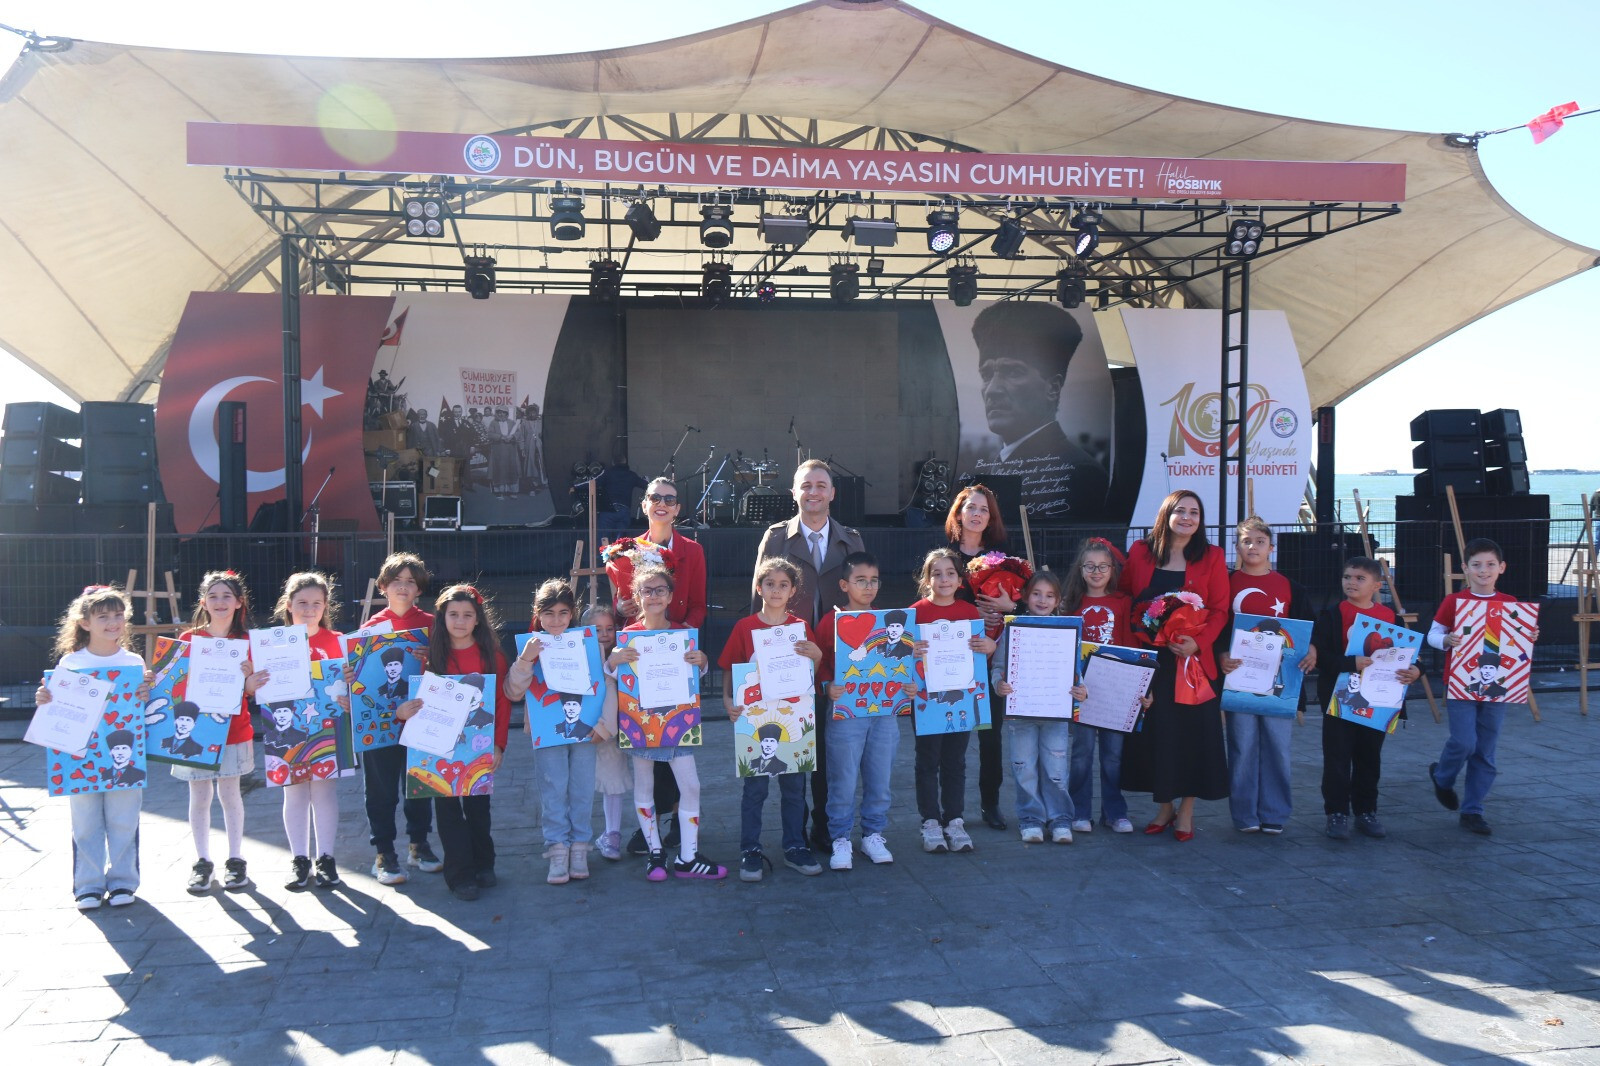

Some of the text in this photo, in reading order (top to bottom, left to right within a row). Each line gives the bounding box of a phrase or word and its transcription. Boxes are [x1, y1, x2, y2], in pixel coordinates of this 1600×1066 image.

[514, 143, 584, 174] DÜN,
[595, 148, 696, 174] BUGÜN
[706, 155, 742, 176] VE
[752, 153, 843, 181] DAİMA
[847, 159, 960, 186] YAŞASIN
[969, 162, 1144, 189] CUMHURİYET!
[1156, 161, 1195, 190] Halil
[1168, 179, 1222, 190] POSBIYIK
[466, 395, 512, 405] KAZANDIK
[1249, 440, 1297, 463] Yaşında
[1167, 461, 1297, 476] TÜRKİYE UHURİYETİ
